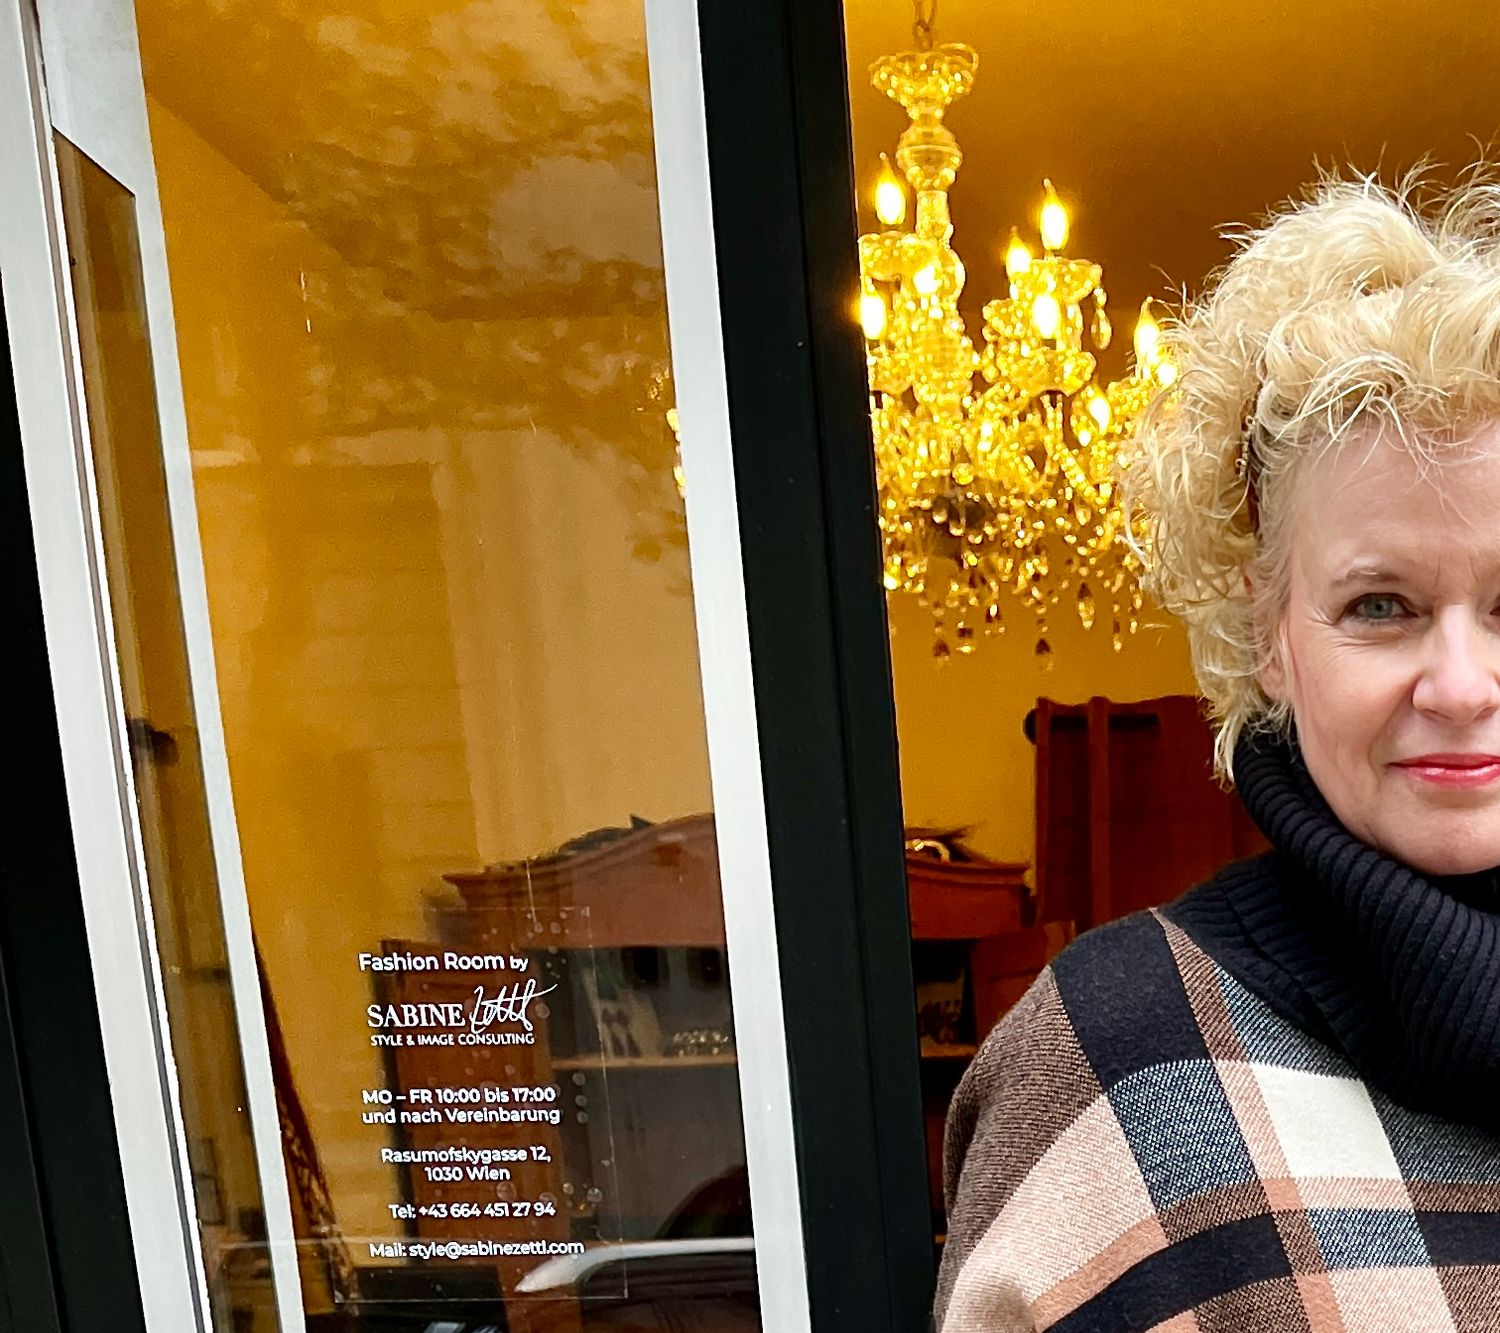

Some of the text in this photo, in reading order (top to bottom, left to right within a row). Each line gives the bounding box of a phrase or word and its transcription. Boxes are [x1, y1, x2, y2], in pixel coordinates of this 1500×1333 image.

[358, 952, 529, 971] Fashion Room by
[367, 1003, 466, 1028] SABINE
[370, 1033, 535, 1046] STYLE & IMAGE CONSULTING
[362, 1090, 392, 1104] MO
[410, 1090, 432, 1103] FR
[436, 1089, 480, 1103] 10:00
[484, 1088, 510, 1103] bis
[512, 1087, 556, 1102] 17:00
[362, 1107, 561, 1125] und nach Vereinbarung
[381, 1146, 551, 1165] Rasumofskygasse 12,
[425, 1166, 511, 1181] 1030 Wien
[389, 1202, 556, 1219] Tel: +43 664 451 27 94
[369, 1239, 584, 1260] Mail: style@sabinezettl.com
